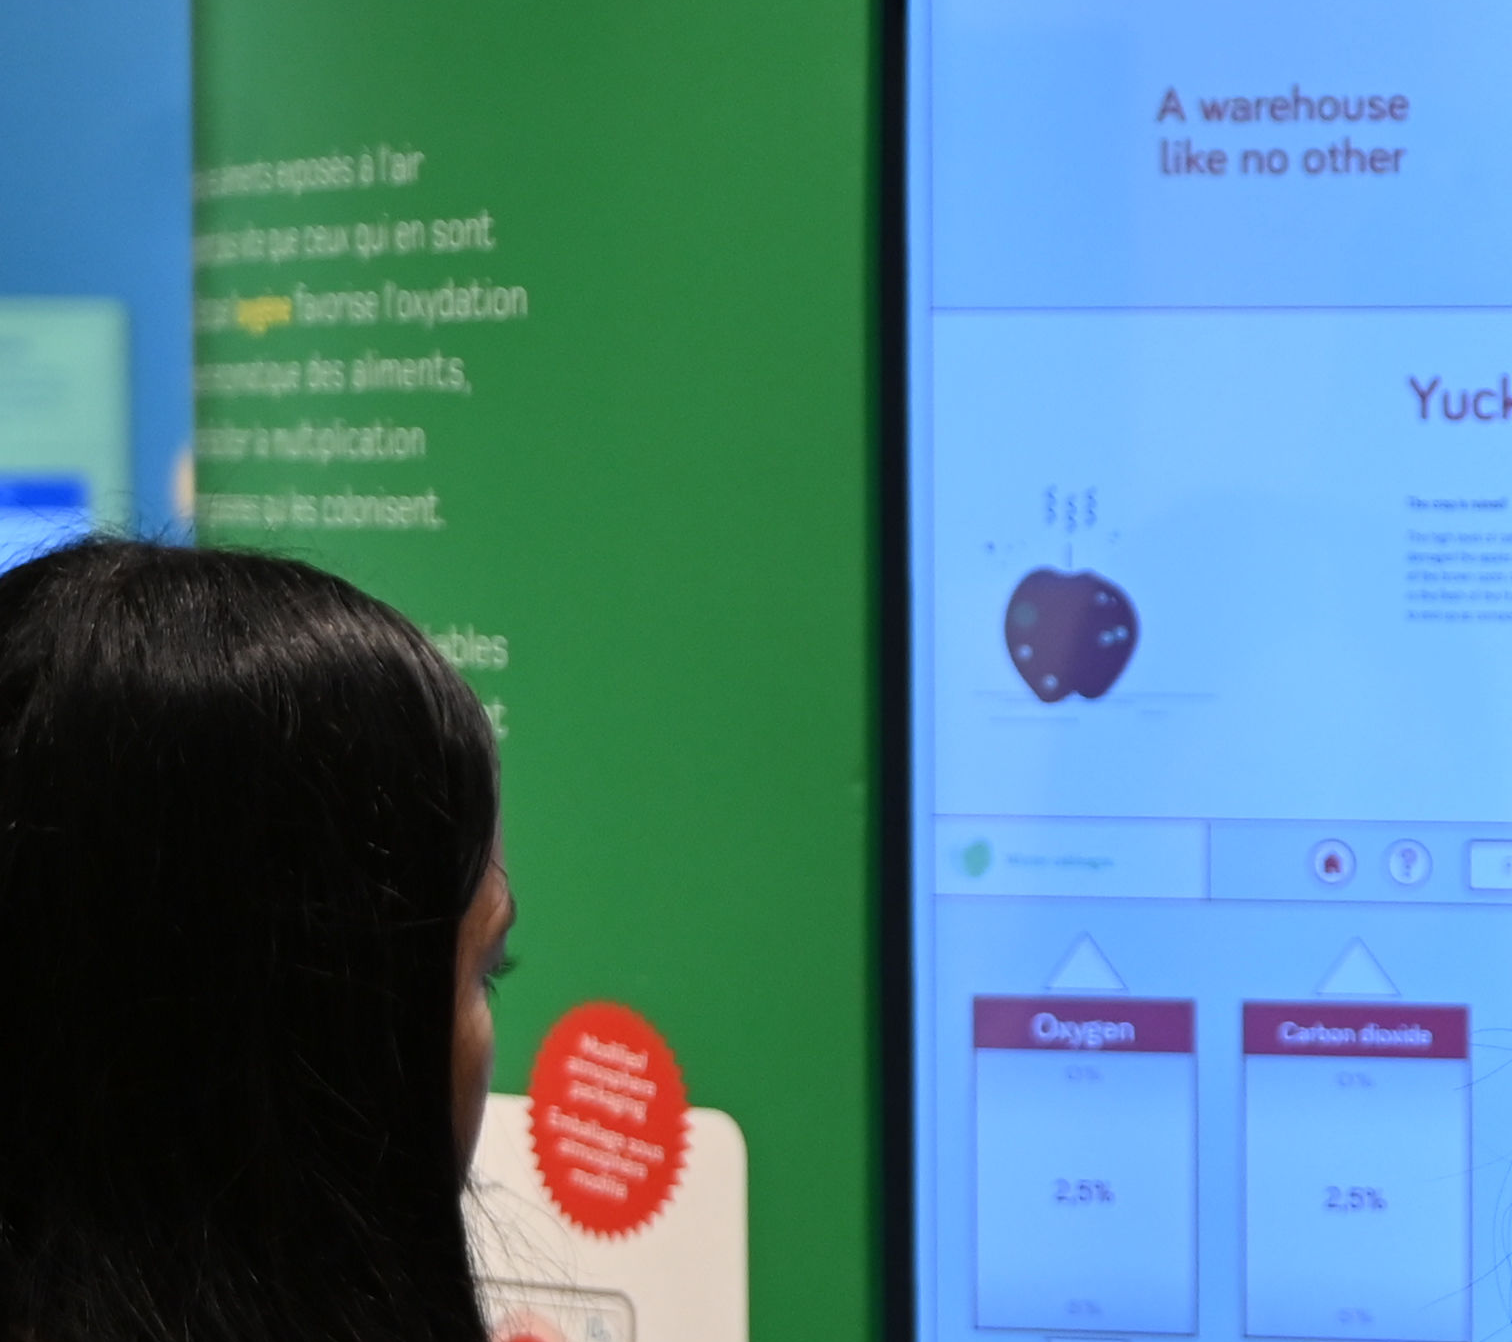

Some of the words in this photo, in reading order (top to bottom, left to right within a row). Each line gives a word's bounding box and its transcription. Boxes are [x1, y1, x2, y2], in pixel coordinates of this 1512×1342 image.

[1156, 86, 1186, 123] A
[1198, 85, 1410, 124] warehouse
[1160, 140, 1228, 175] like
[1240, 147, 1290, 175] no
[1302, 141, 1406, 175] other
[394, 219, 426, 251] en
[383, 277, 528, 328] l'oxydation
[1032, 1012, 1136, 1048] Oxygen
[1277, 1021, 1357, 1046] Carbon
[1361, 1022, 1434, 1048] dioxide
